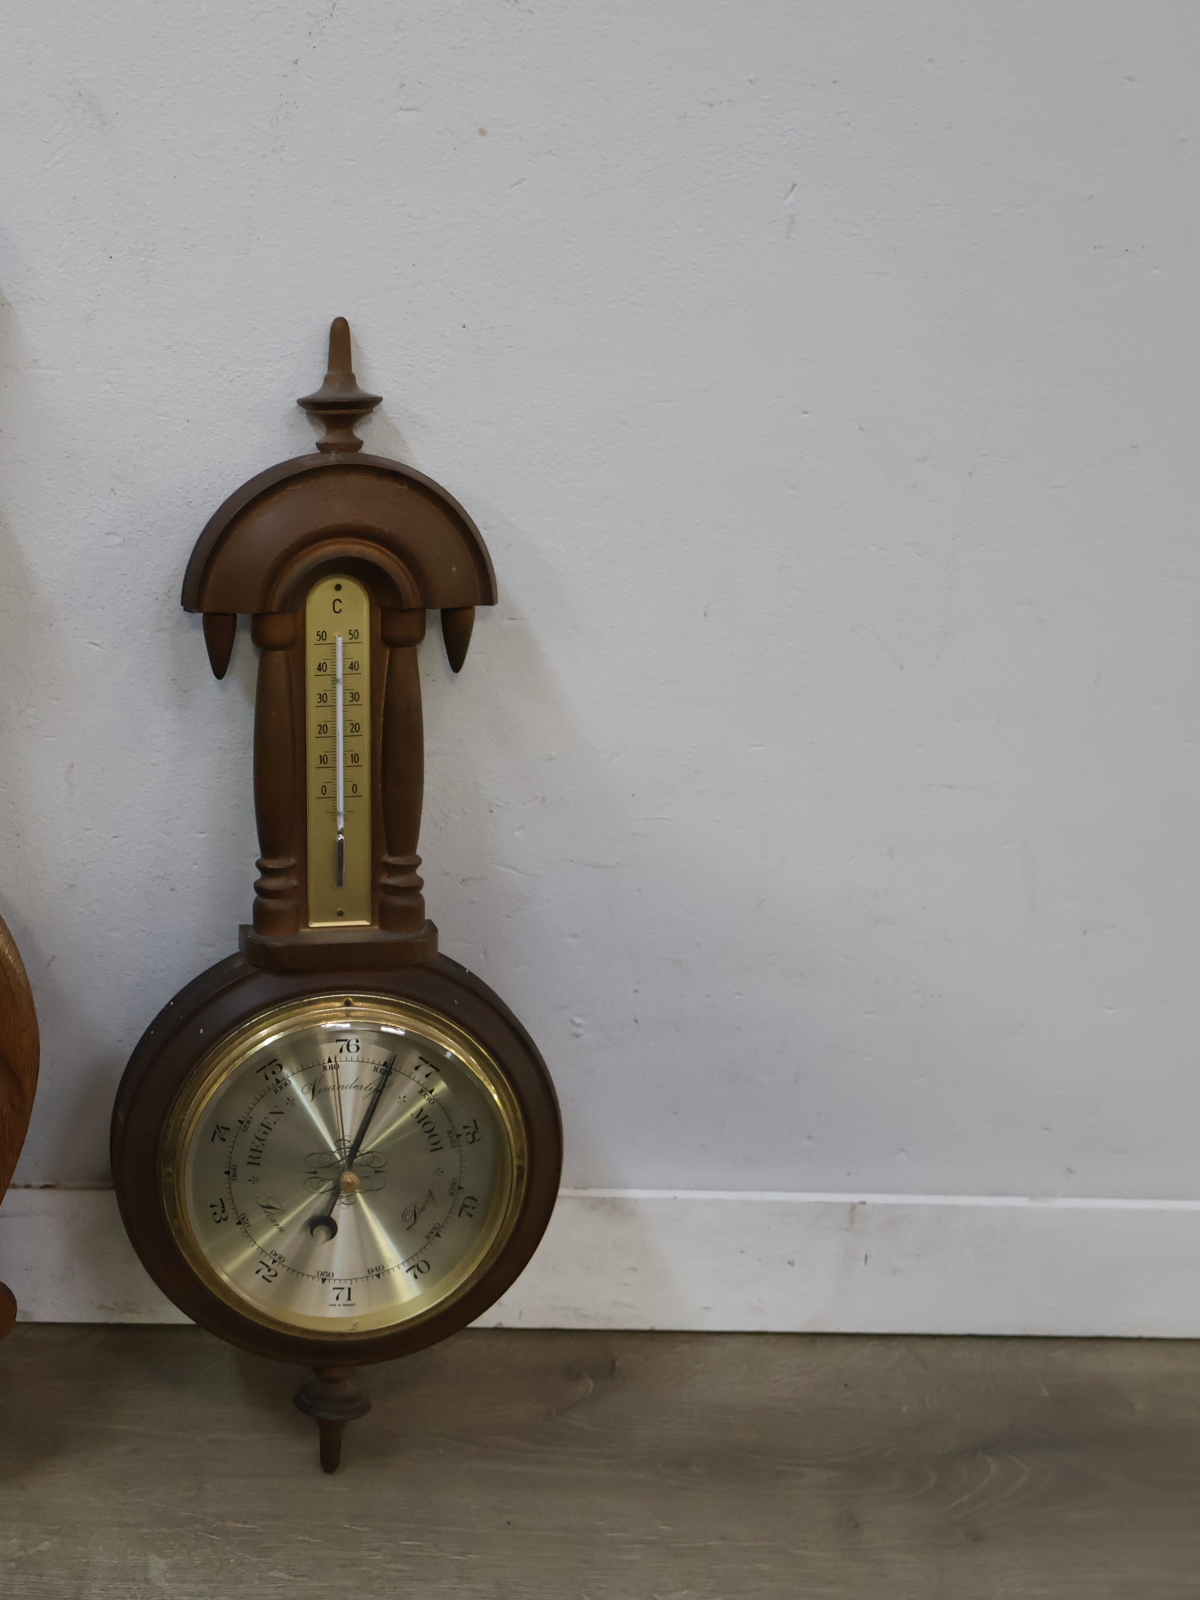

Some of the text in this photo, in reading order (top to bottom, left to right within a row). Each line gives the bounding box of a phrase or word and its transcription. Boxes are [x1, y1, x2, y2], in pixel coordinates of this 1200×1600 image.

[332, 599, 343, 614] C
[316, 630, 327, 641] 50
[348, 629, 359, 640] 50
[316, 662, 328, 673] 40
[348, 661, 360, 671] 40
[316, 693, 328, 704] 30
[349, 692, 360, 703] 30
[317, 724, 328, 735] 20
[349, 722, 361, 734] 20
[318, 754, 329, 765] 10
[350, 753, 360, 764] 10
[320, 785, 327, 796] 0
[351, 783, 358, 794] 0
[335, 1038, 361, 1054] 76
[255, 1058, 284, 1081] 75
[323, 1063, 340, 1072] 1010
[414, 1055, 441, 1079] 77
[273, 1079, 292, 1095] 1000
[418, 1087, 435, 1105] 1030
[210, 1122, 231, 1144] 74
[246, 1104, 285, 1167] REGEN
[410, 1106, 444, 1153] MOOI
[462, 1118, 482, 1146] 78
[209, 1197, 229, 1224] 73
[458, 1195, 479, 1219] 79
[255, 1260, 279, 1284] 72
[316, 1270, 335, 1278] 950
[366, 1264, 385, 1275] 940
[405, 1259, 432, 1280] 70
[332, 1286, 353, 1302] 71
